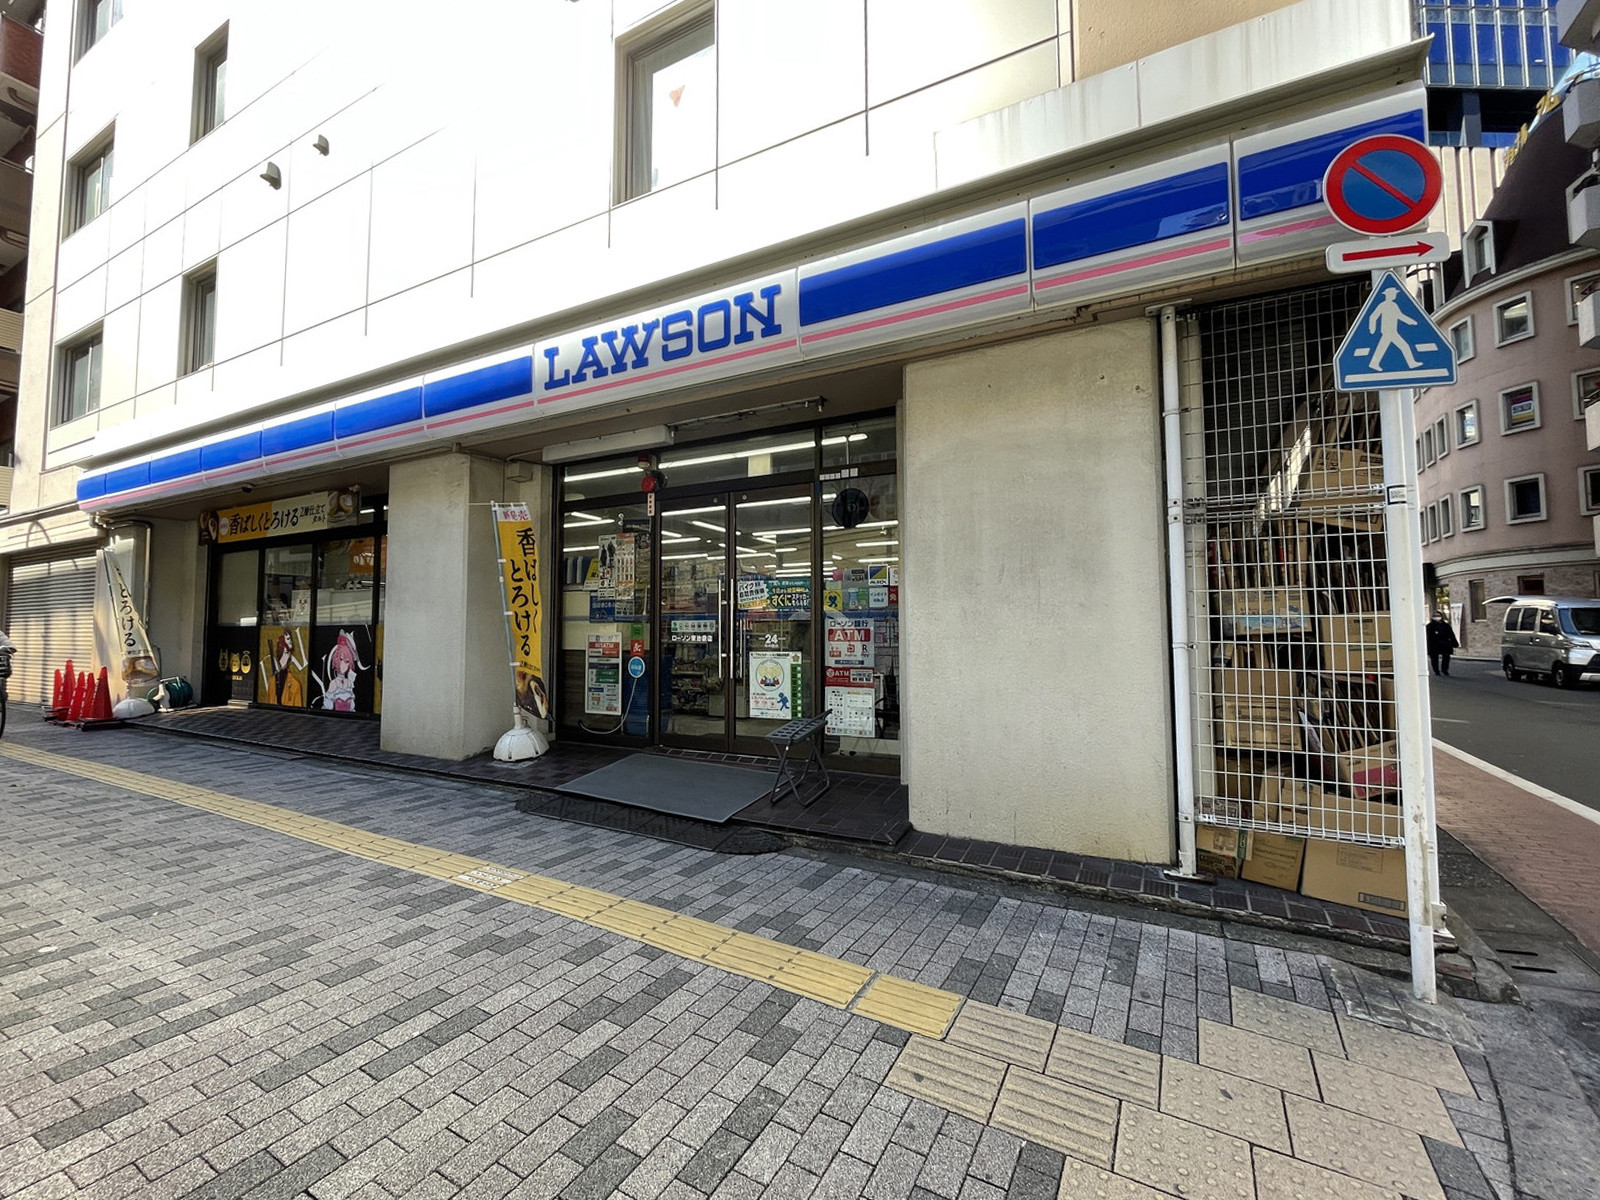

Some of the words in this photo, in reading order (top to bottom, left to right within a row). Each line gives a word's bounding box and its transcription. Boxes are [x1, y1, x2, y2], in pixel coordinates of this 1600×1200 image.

[543, 283, 783, 391] LAWSON
[229, 508, 299, 536] 香ばしくとろける
[510, 558, 531, 657] とろける
[771, 594, 791, 607] すぐに
[119, 582, 137, 648] とろける
[765, 634, 778, 644] 24
[834, 630, 864, 641] ATM
